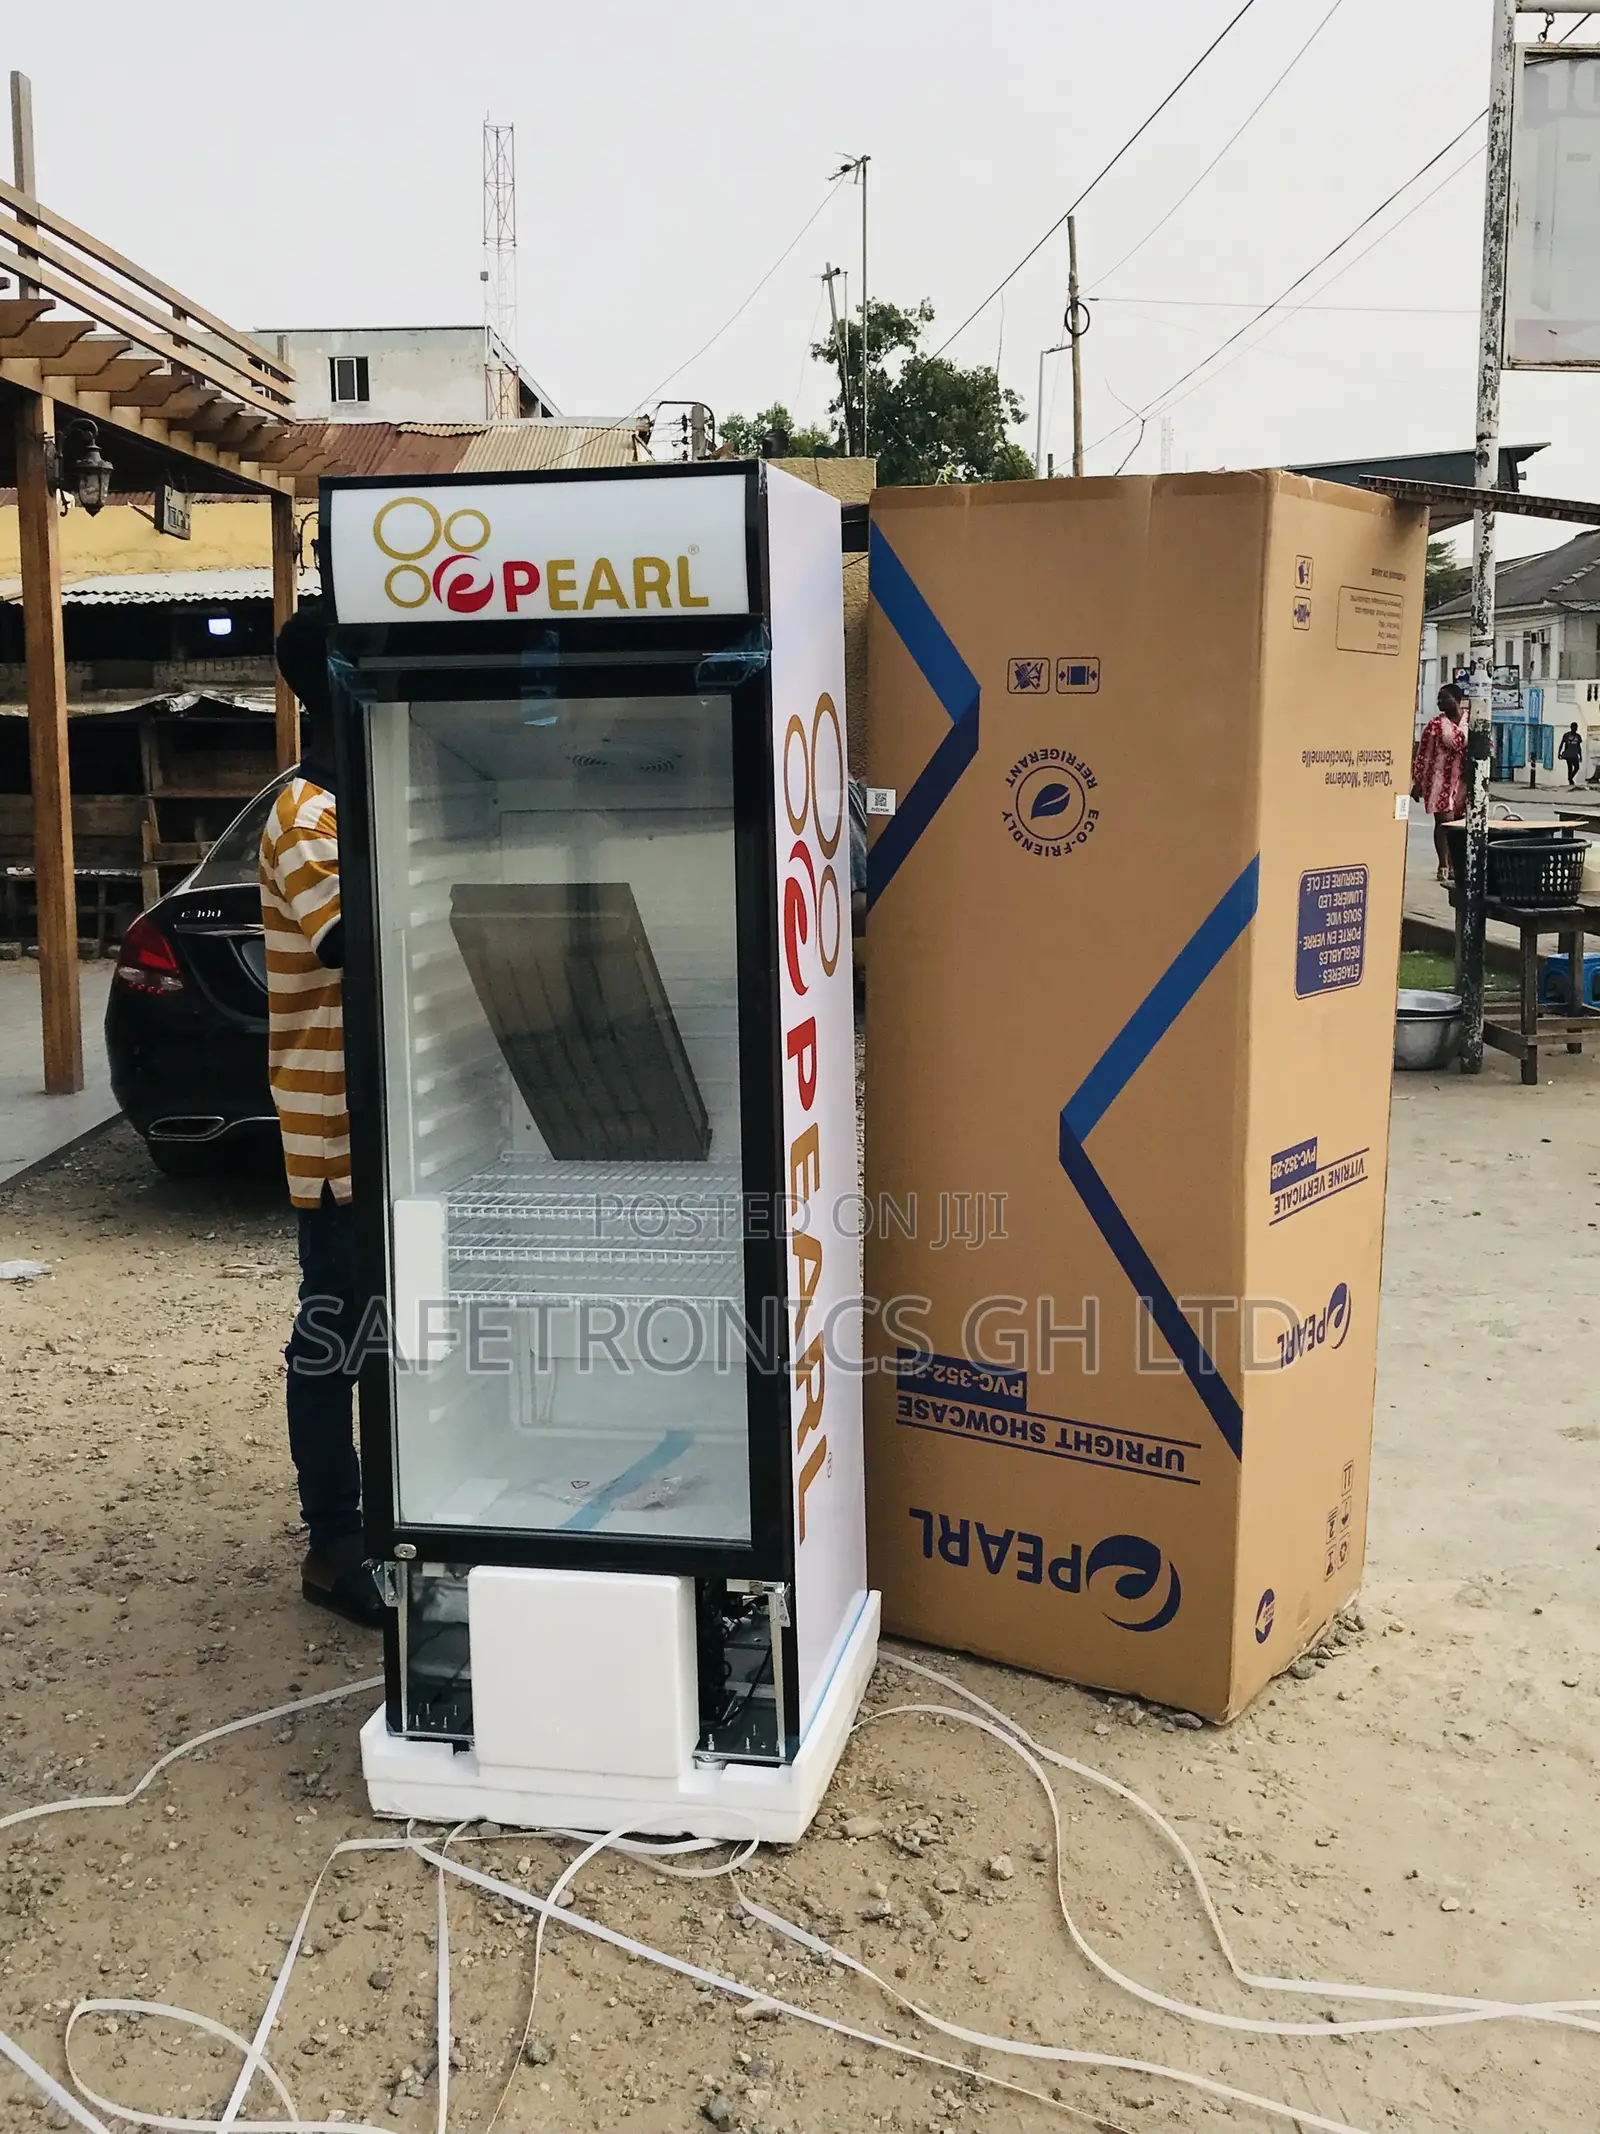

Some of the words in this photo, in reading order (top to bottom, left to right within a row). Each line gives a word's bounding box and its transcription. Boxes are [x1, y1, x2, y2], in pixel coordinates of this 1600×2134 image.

[502, 555, 709, 613] PEARL
[1005, 748, 1098, 789] REFRIGERANT
[1002, 809, 1099, 857] ECO-FRIENDLY
[1306, 877, 1320, 895] CLÉ
[1321, 875, 1331, 889] ET
[1332, 871, 1364, 888] SERRURE
[1318, 893, 1332, 909] LED
[1333, 889, 1363, 909] LUMIÈRE
[1326, 911, 1342, 926] VIDE
[1343, 909, 1362, 924] SOUS
[1303, 934, 1326, 950] VERRE
[1327, 931, 1337, 944] EN
[1338, 926, 1361, 944] PORTE
[1271, 1146, 1317, 1180] PVC-352-2B
[1328, 1158, 1364, 1188] VITRINE
[1274, 1175, 1325, 1215] VERTICALE
[787, 1016, 826, 1546] PEARL
[1277, 1307, 1327, 1369] PEARL
[898, 1395, 1046, 1444] SHOWCASE
[1055, 1427, 1185, 1472] UPRIGHT
[909, 1507, 1082, 1594] PEARL
